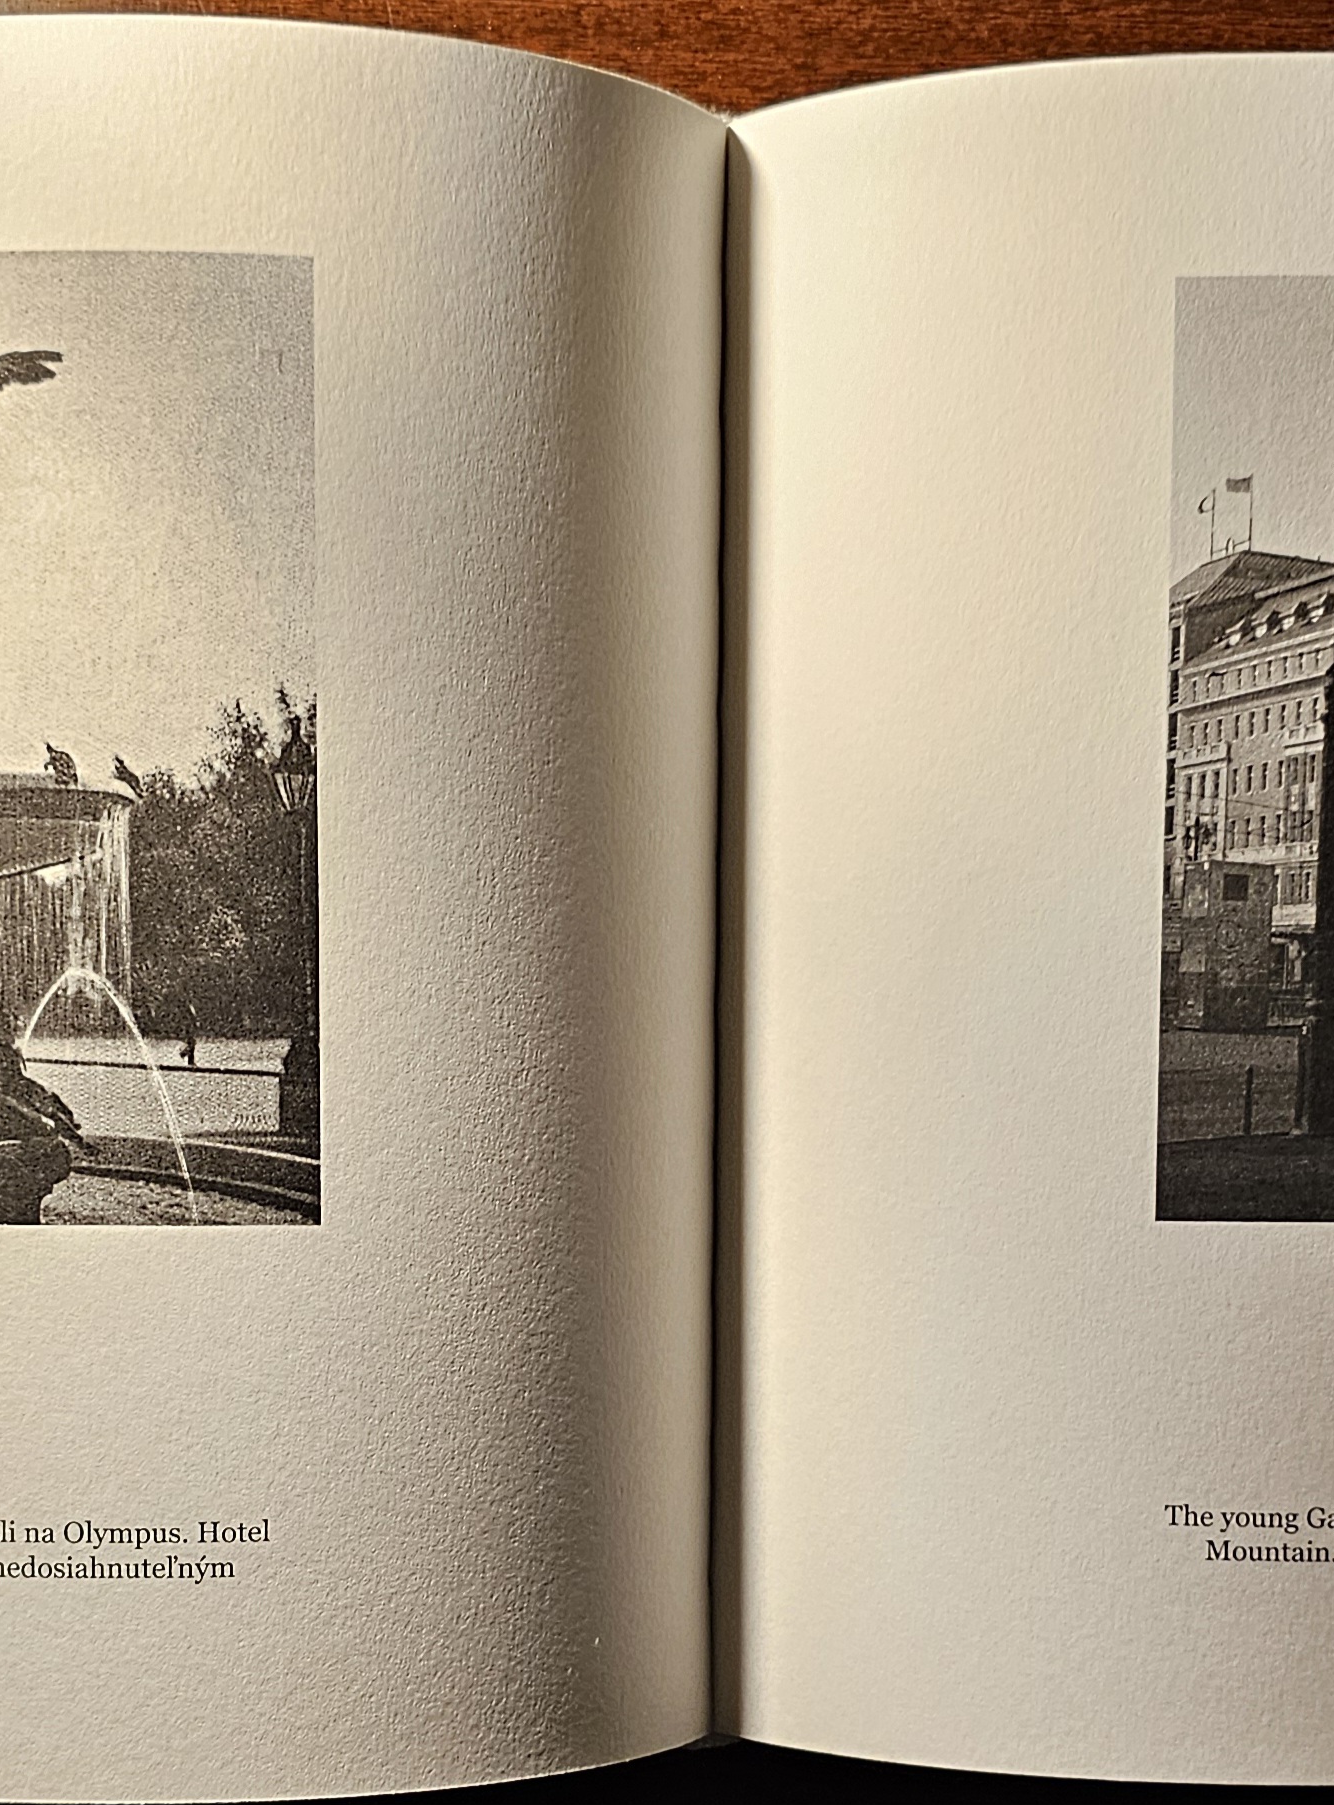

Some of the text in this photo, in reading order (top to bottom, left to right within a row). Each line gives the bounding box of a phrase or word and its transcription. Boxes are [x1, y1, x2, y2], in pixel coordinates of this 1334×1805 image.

[24, 1527, 56, 1544] na
[63, 1519, 188, 1550] Olympus.
[197, 1518, 271, 1544] Hotel
[1164, 1503, 1214, 1527] The
[1219, 1511, 1300, 1535] young
